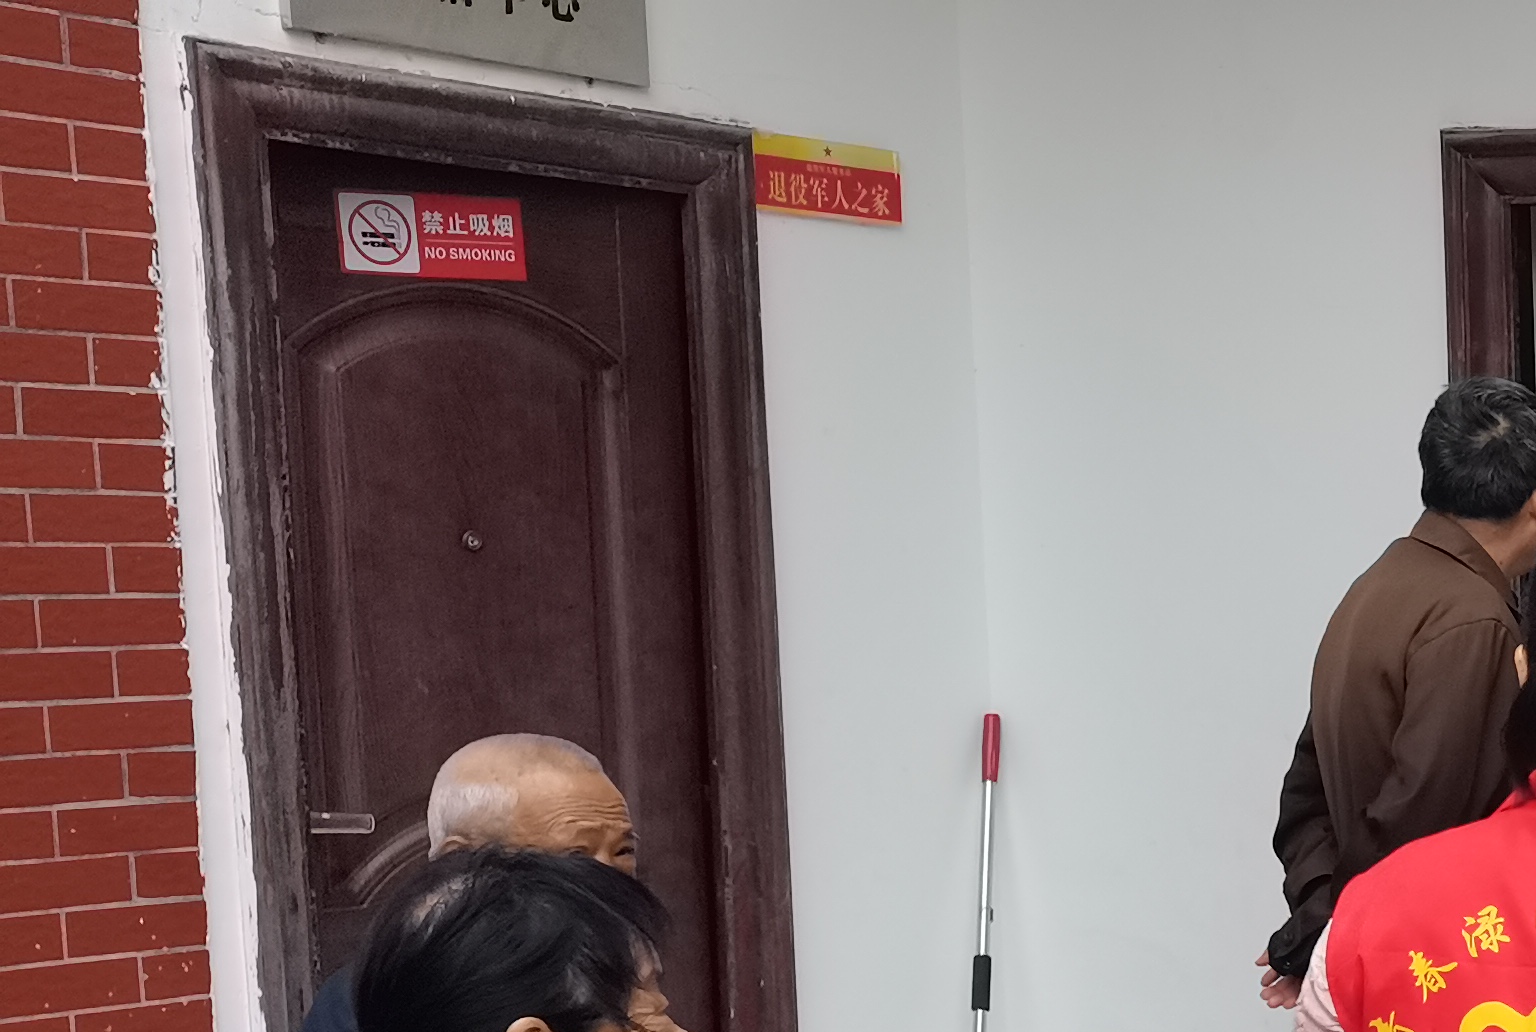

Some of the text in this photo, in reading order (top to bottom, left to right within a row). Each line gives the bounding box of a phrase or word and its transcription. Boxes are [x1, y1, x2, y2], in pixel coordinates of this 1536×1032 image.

[768, 170, 890, 216] 退役军人之家
[421, 210, 514, 238] 禁止吸烟
[424, 246, 516, 262] NO SMOKING
